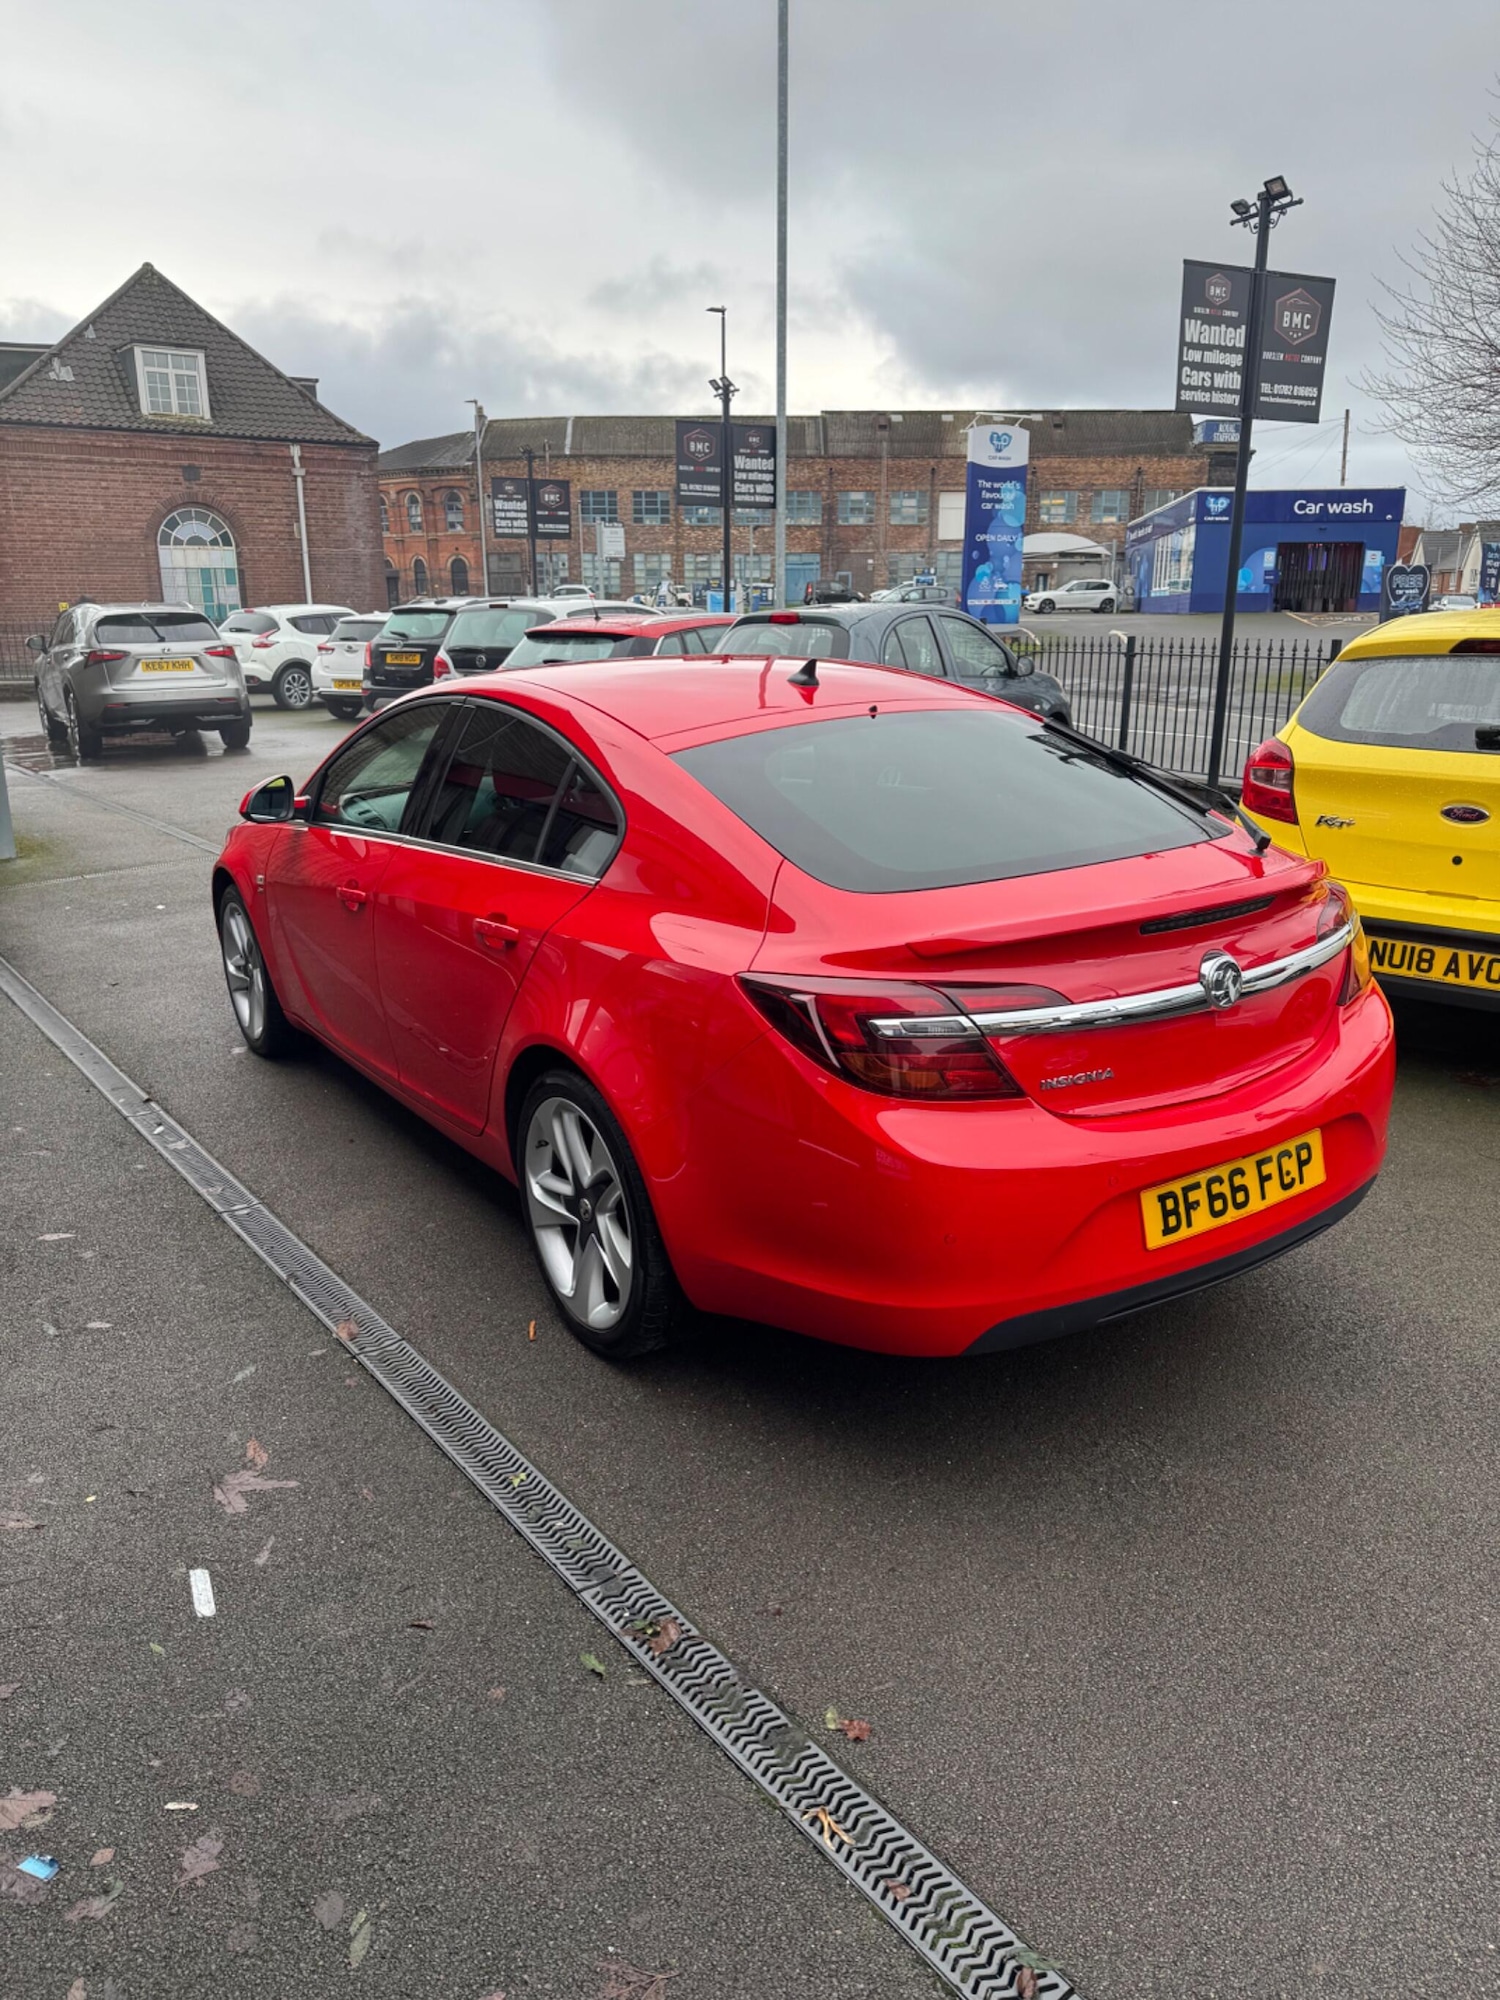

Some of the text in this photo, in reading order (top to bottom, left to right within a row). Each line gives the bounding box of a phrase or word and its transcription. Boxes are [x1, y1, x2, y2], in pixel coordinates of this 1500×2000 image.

[1210, 285, 1227, 297] BMC
[1282, 311, 1312, 330] BMC
[1184, 318, 1246, 348] Wanted
[1182, 346, 1243, 368] Low mileage
[1182, 366, 1242, 390] Cars with
[1180, 389, 1240, 406] service history
[1213, 432, 1240, 442] STAFFORD
[689, 441, 710, 452] BMC
[734, 455, 774, 470] Wanted
[734, 482, 754, 493] Cars
[977, 479, 992, 488] The
[981, 502, 994, 510] car
[1294, 498, 1374, 514] Car wash
[975, 534, 1018, 542] OPEN DAILY
[1370, 940, 1436, 974] NU18
[1039, 1067, 1115, 1091] INSIGNIA
[1157, 1141, 1313, 1237] BF66 FCP
